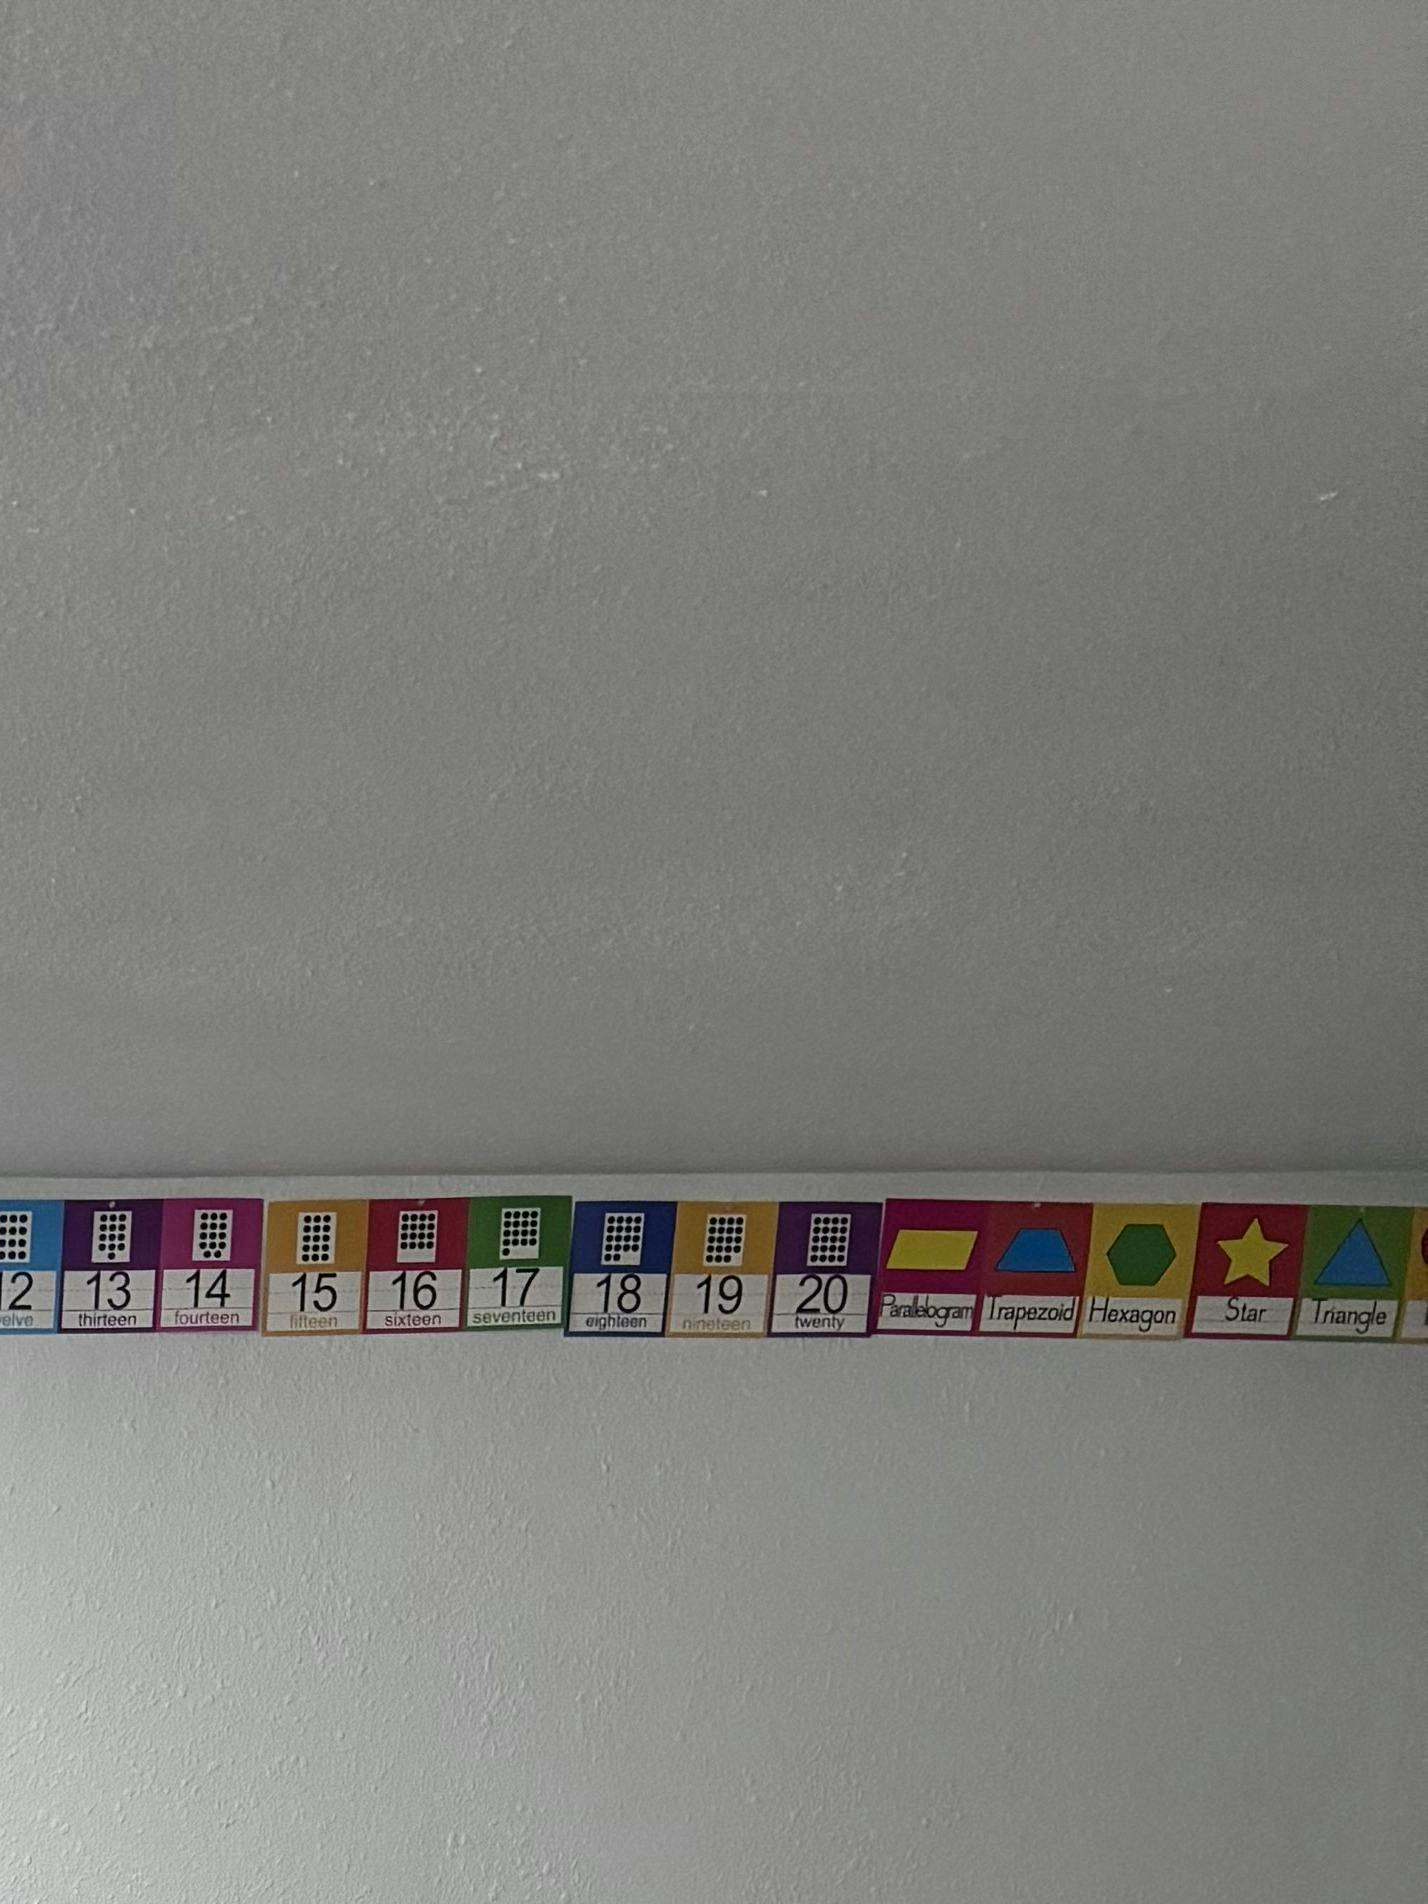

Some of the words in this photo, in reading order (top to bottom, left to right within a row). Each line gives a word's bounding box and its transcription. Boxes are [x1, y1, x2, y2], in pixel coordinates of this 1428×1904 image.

[86, 1270, 132, 1311] 13
[186, 1269, 231, 1308] 14
[291, 1272, 337, 1312] 15
[391, 1270, 437, 1311] 16
[493, 1266, 540, 1307] 17
[596, 1273, 642, 1314] 18
[696, 1274, 743, 1314] 19
[795, 1273, 848, 1314] 20
[78, 1312, 137, 1327] thirteen
[174, 1309, 240, 1326] fourteen
[290, 1314, 338, 1329] fifteen
[384, 1312, 442, 1327] sixteen
[472, 1309, 556, 1324] seventeen
[585, 1314, 647, 1330] eighteen
[682, 1315, 751, 1331] nineteen
[794, 1315, 845, 1331] twenty
[880, 1294, 973, 1327] Parallelogram
[985, 1294, 1074, 1330] Trapezoid
[1089, 1296, 1176, 1333] Hexagon
[1225, 1296, 1267, 1323] Star
[1312, 1299, 1387, 1335] Triangle
